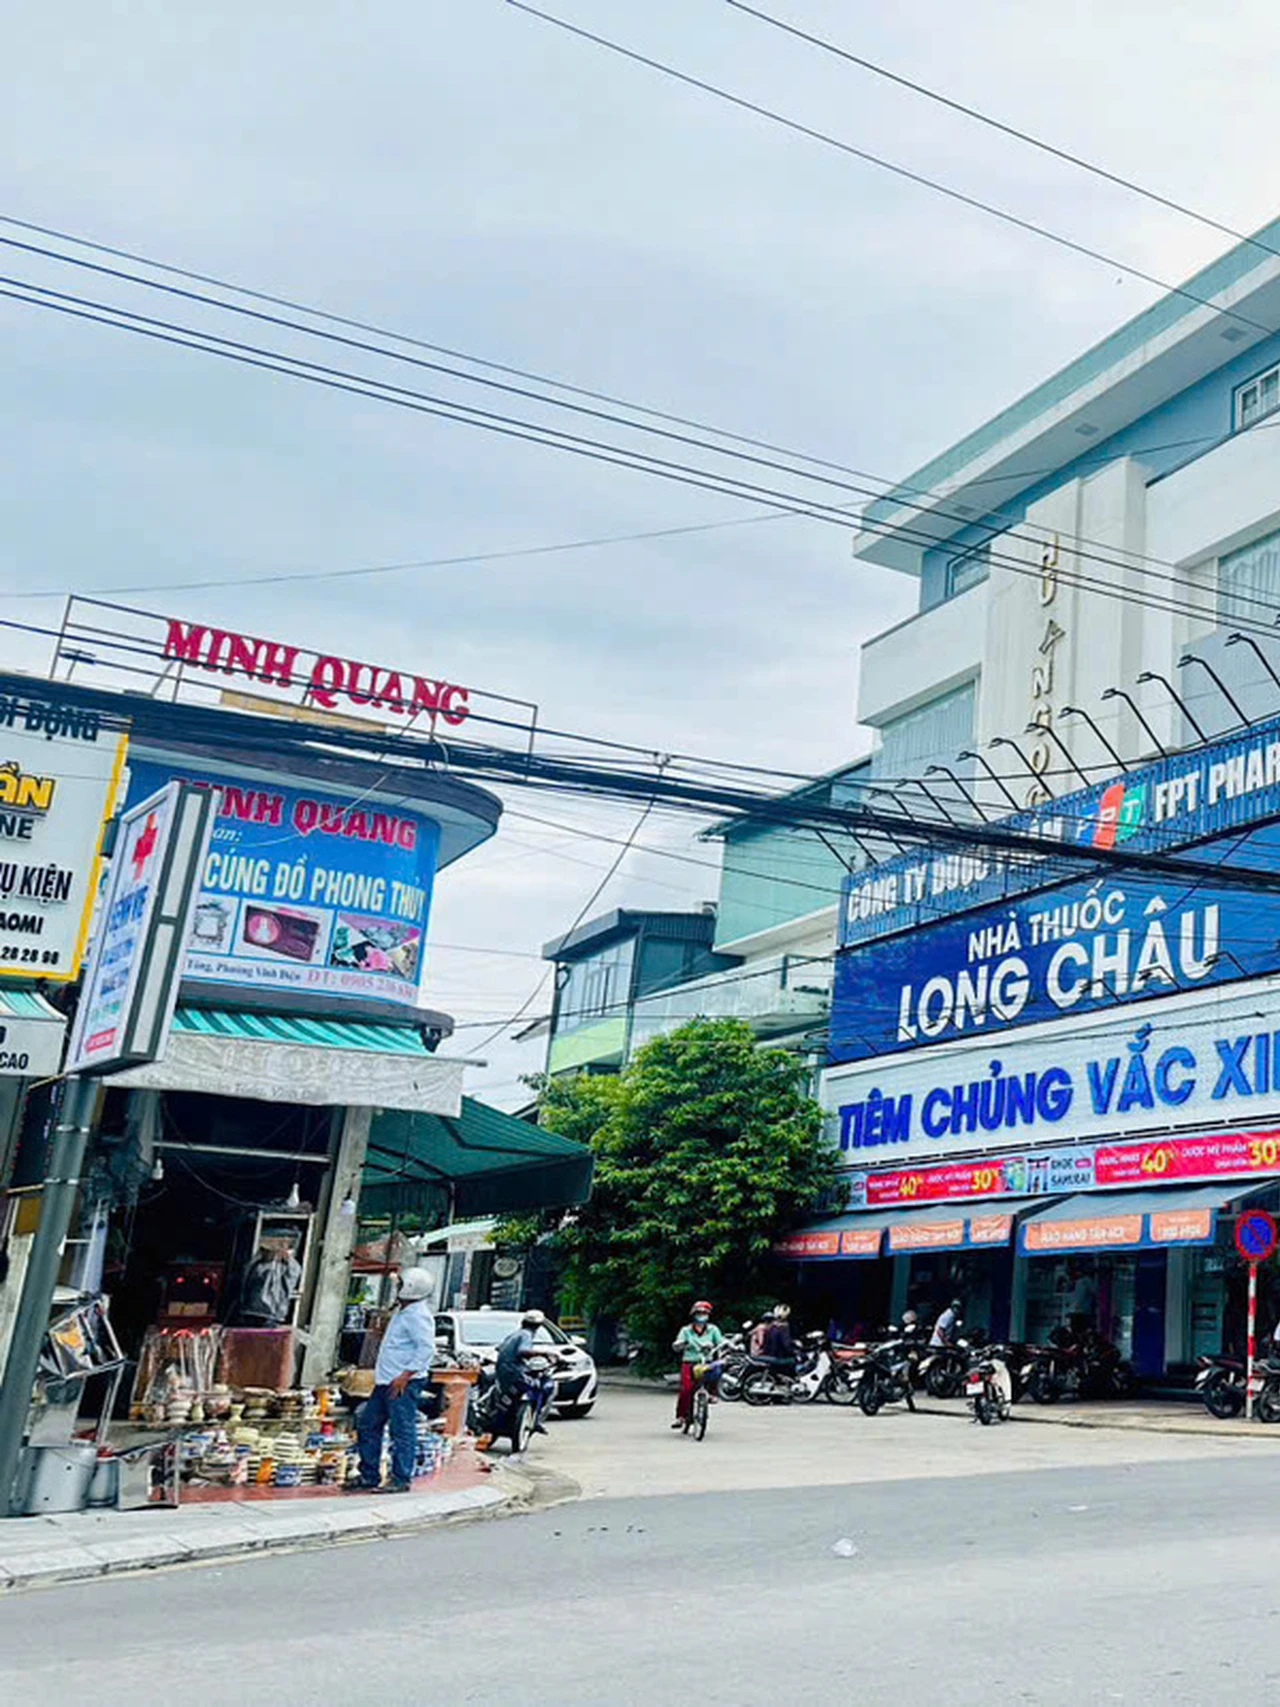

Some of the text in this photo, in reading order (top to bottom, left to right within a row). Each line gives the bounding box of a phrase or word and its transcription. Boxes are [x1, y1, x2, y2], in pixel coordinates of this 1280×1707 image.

[160, 619, 470, 726] MINH QUANG
[293, 799, 417, 849] QUANG
[1155, 771, 1200, 823] FPT
[19, 863, 73, 903] KIỆN
[203, 847, 269, 896] CÚNG
[273, 853, 307, 900] ĐỒ
[310, 867, 386, 912] PHONG
[848, 877, 897, 923] CÔNG
[904, 862, 926, 904] TY
[968, 879, 1126, 963] NHÀ THUỐC
[898, 895, 1219, 1042] LONG CHÂU
[838, 1088, 910, 1151] TIÊM
[921, 1061, 1073, 1138] CHỦNG
[1086, 1022, 1198, 1116] VẮC
